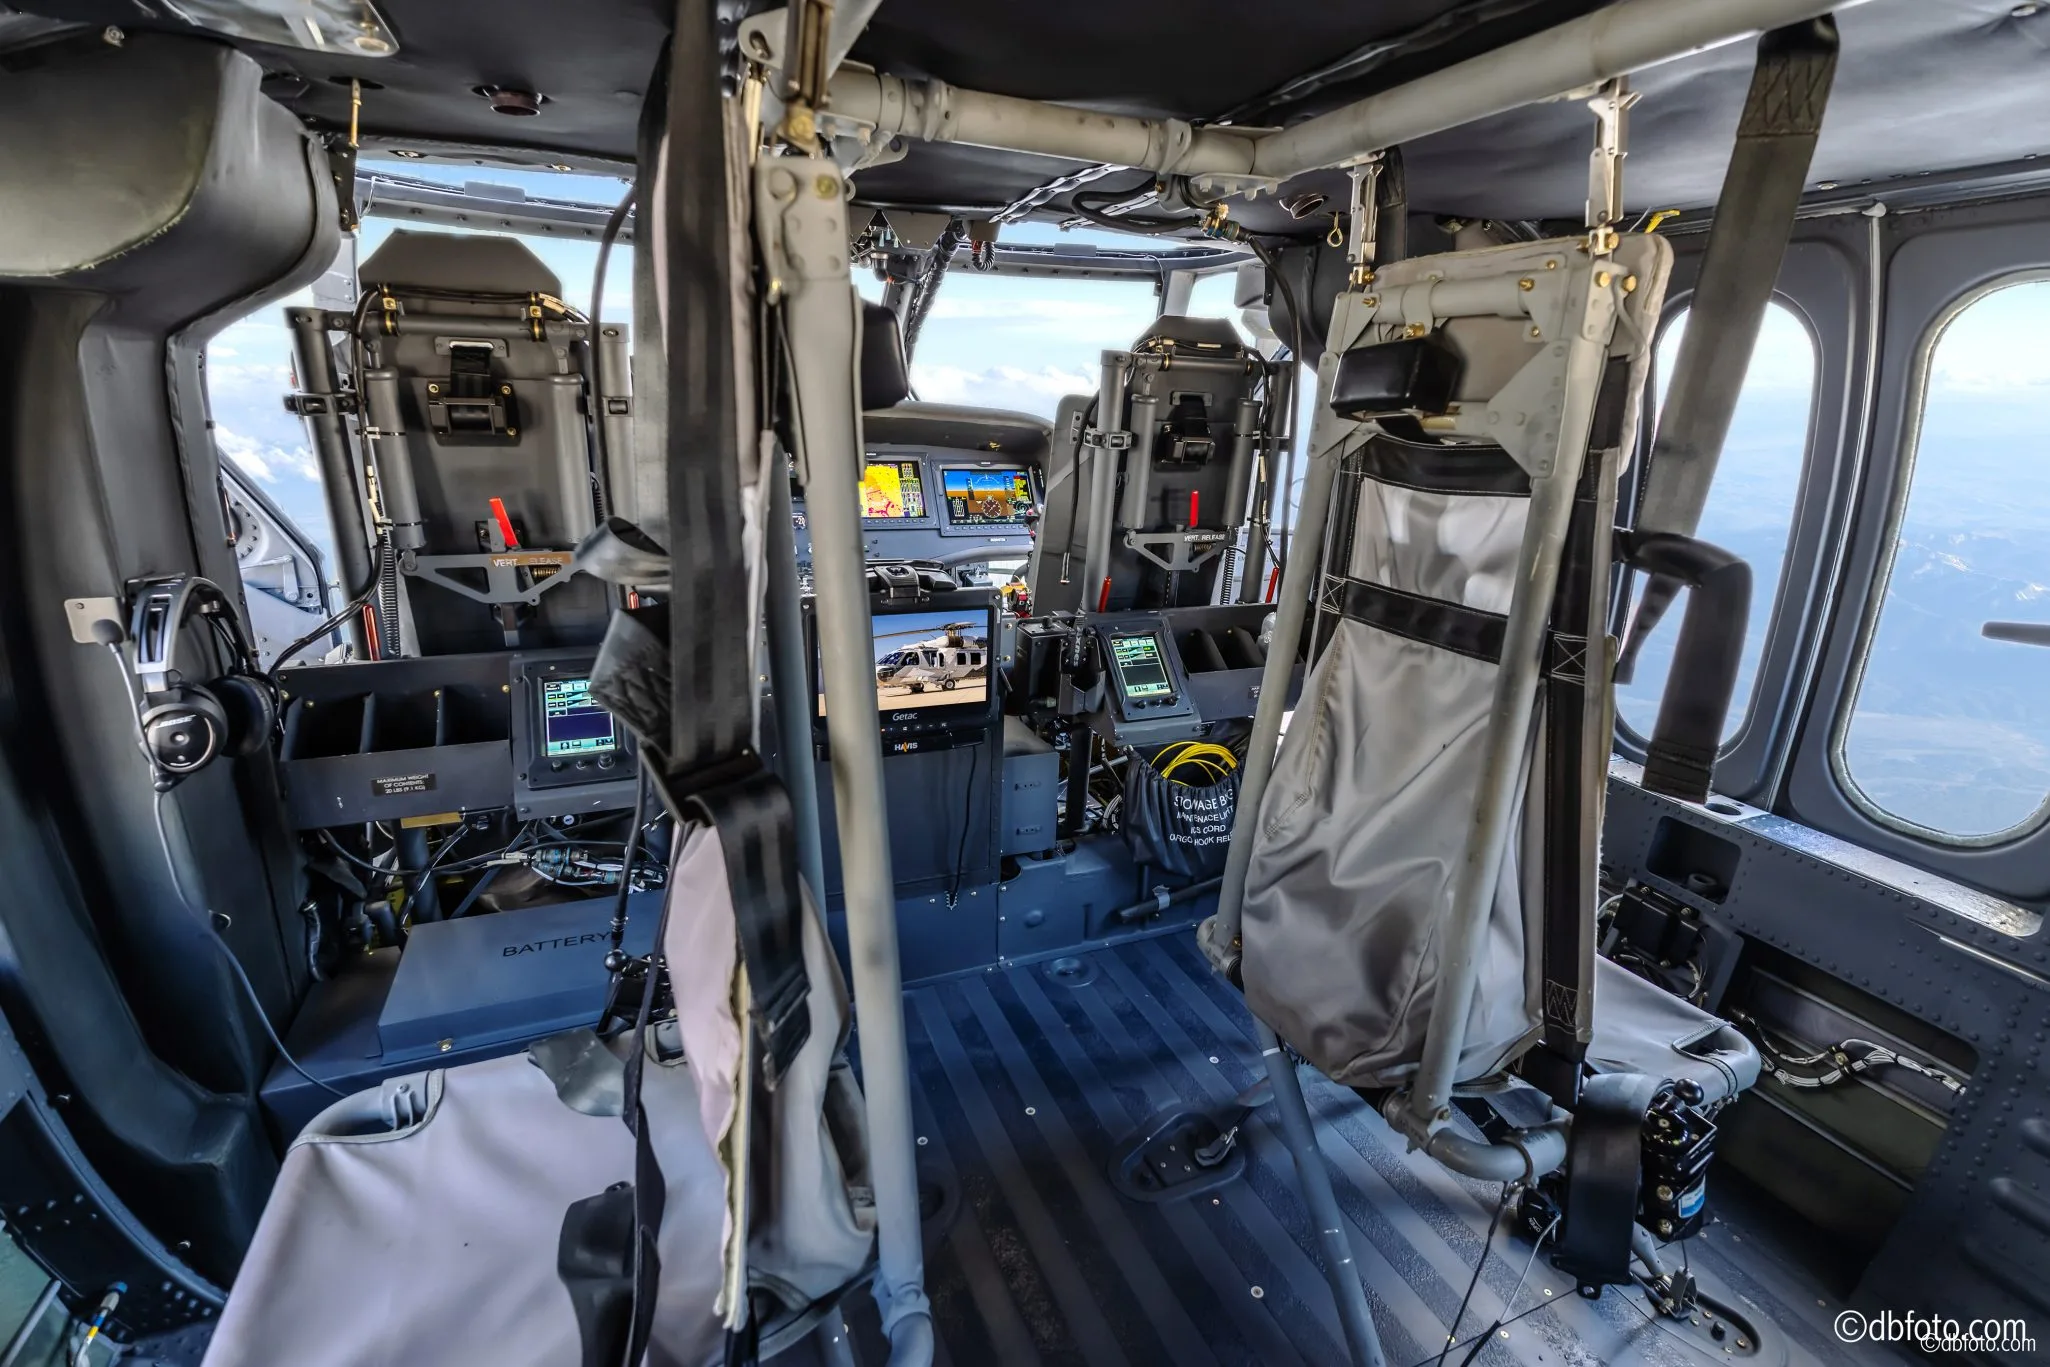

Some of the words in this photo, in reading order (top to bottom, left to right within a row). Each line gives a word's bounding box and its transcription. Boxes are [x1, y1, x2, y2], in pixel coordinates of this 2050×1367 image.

[1201, 533, 1226, 541] RELEASE
[892, 712, 918, 721] Getac
[155, 714, 197, 729] BOSE
[894, 741, 918, 752] HAVIS
[376, 776, 407, 784] MAXIMUM
[1202, 825, 1226, 834] CORD
[1194, 836, 1215, 846] HOOK
[502, 931, 611, 957] BATTERY
